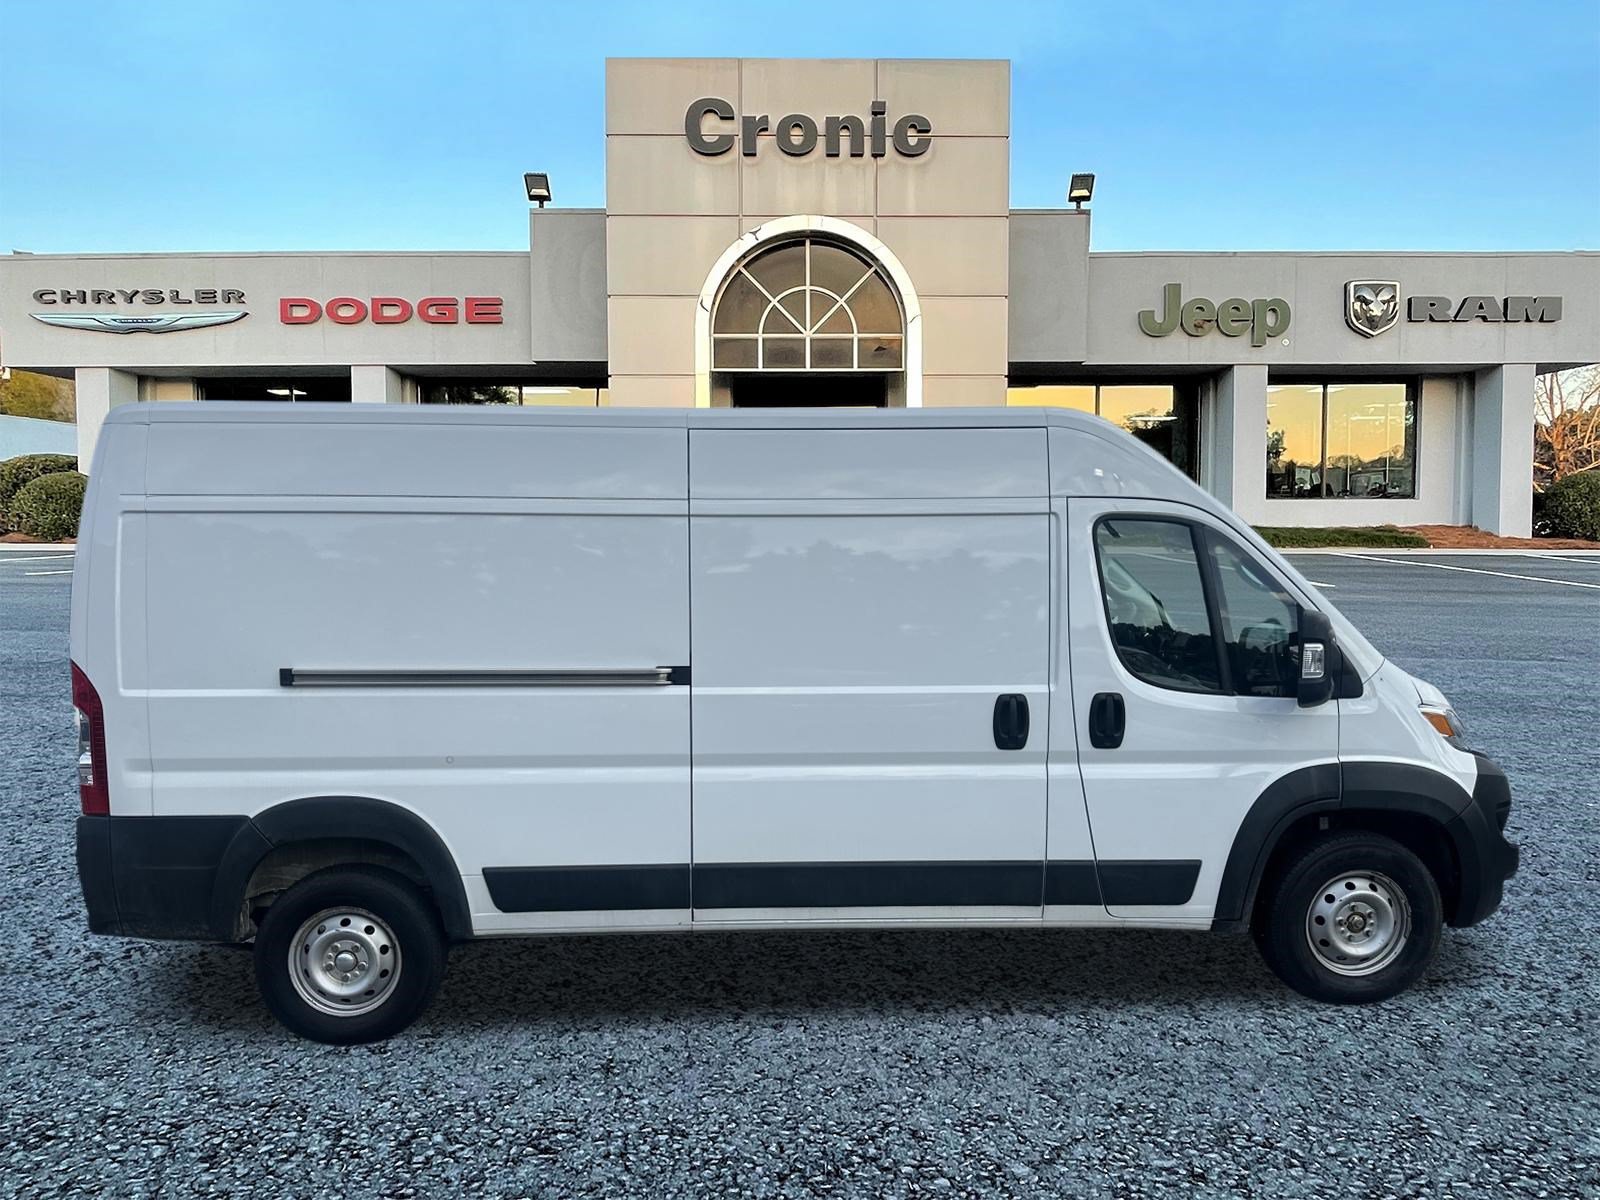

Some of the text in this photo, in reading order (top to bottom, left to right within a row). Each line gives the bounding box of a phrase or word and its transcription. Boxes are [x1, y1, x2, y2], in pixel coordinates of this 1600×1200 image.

[685, 98, 932, 157] Cronic
[32, 288, 246, 304] CHRYSLER
[279, 296, 504, 324] DODGE
[1407, 296, 1563, 322] RAM
[1138, 283, 1291, 347] Jeep
